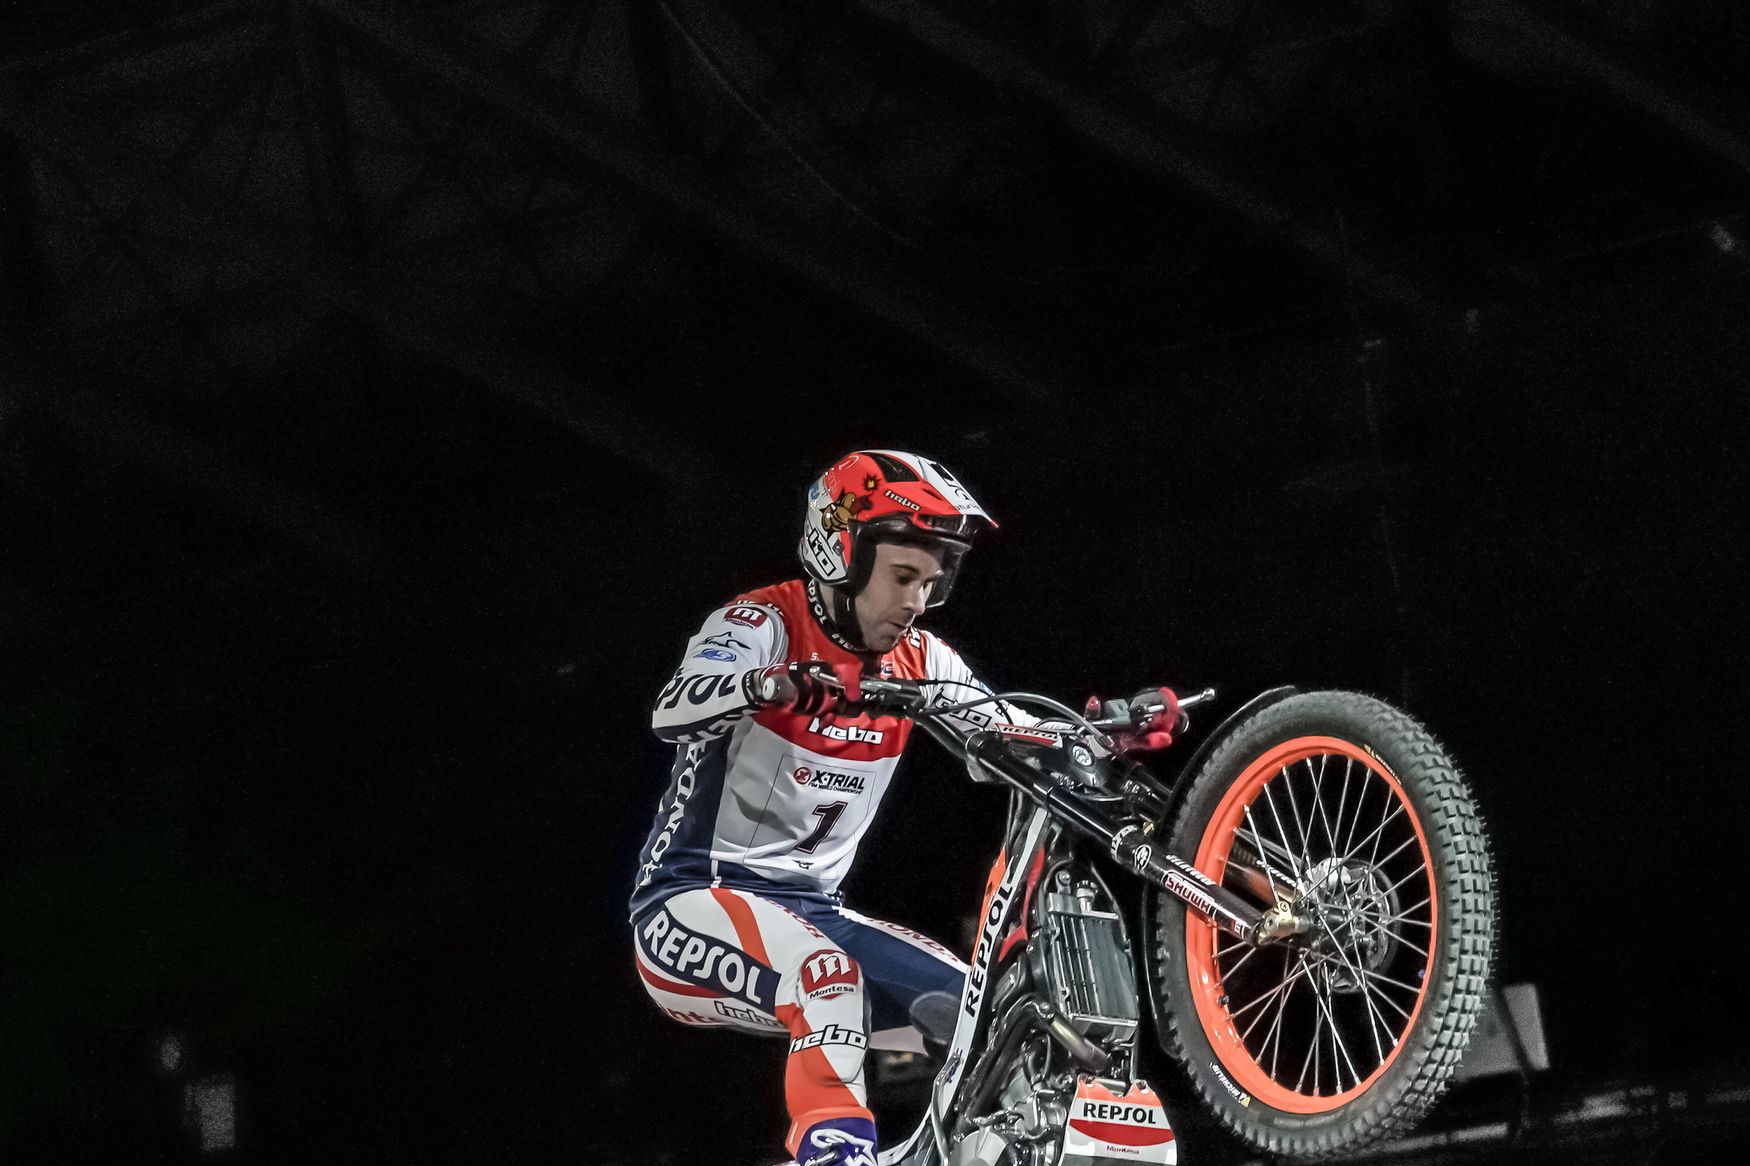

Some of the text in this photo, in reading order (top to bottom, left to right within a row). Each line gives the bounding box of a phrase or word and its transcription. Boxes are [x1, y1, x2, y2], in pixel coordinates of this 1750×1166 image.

[885, 489, 922, 511] hebo
[808, 716, 884, 745] hebo
[795, 800, 849, 854] 1
[644, 910, 762, 1004] REPSOL
[966, 886, 1013, 1018] REPSOL
[809, 985, 855, 1000] Montesa
[789, 1024, 868, 1055] hebo
[1083, 1103, 1156, 1124] REPSOL
